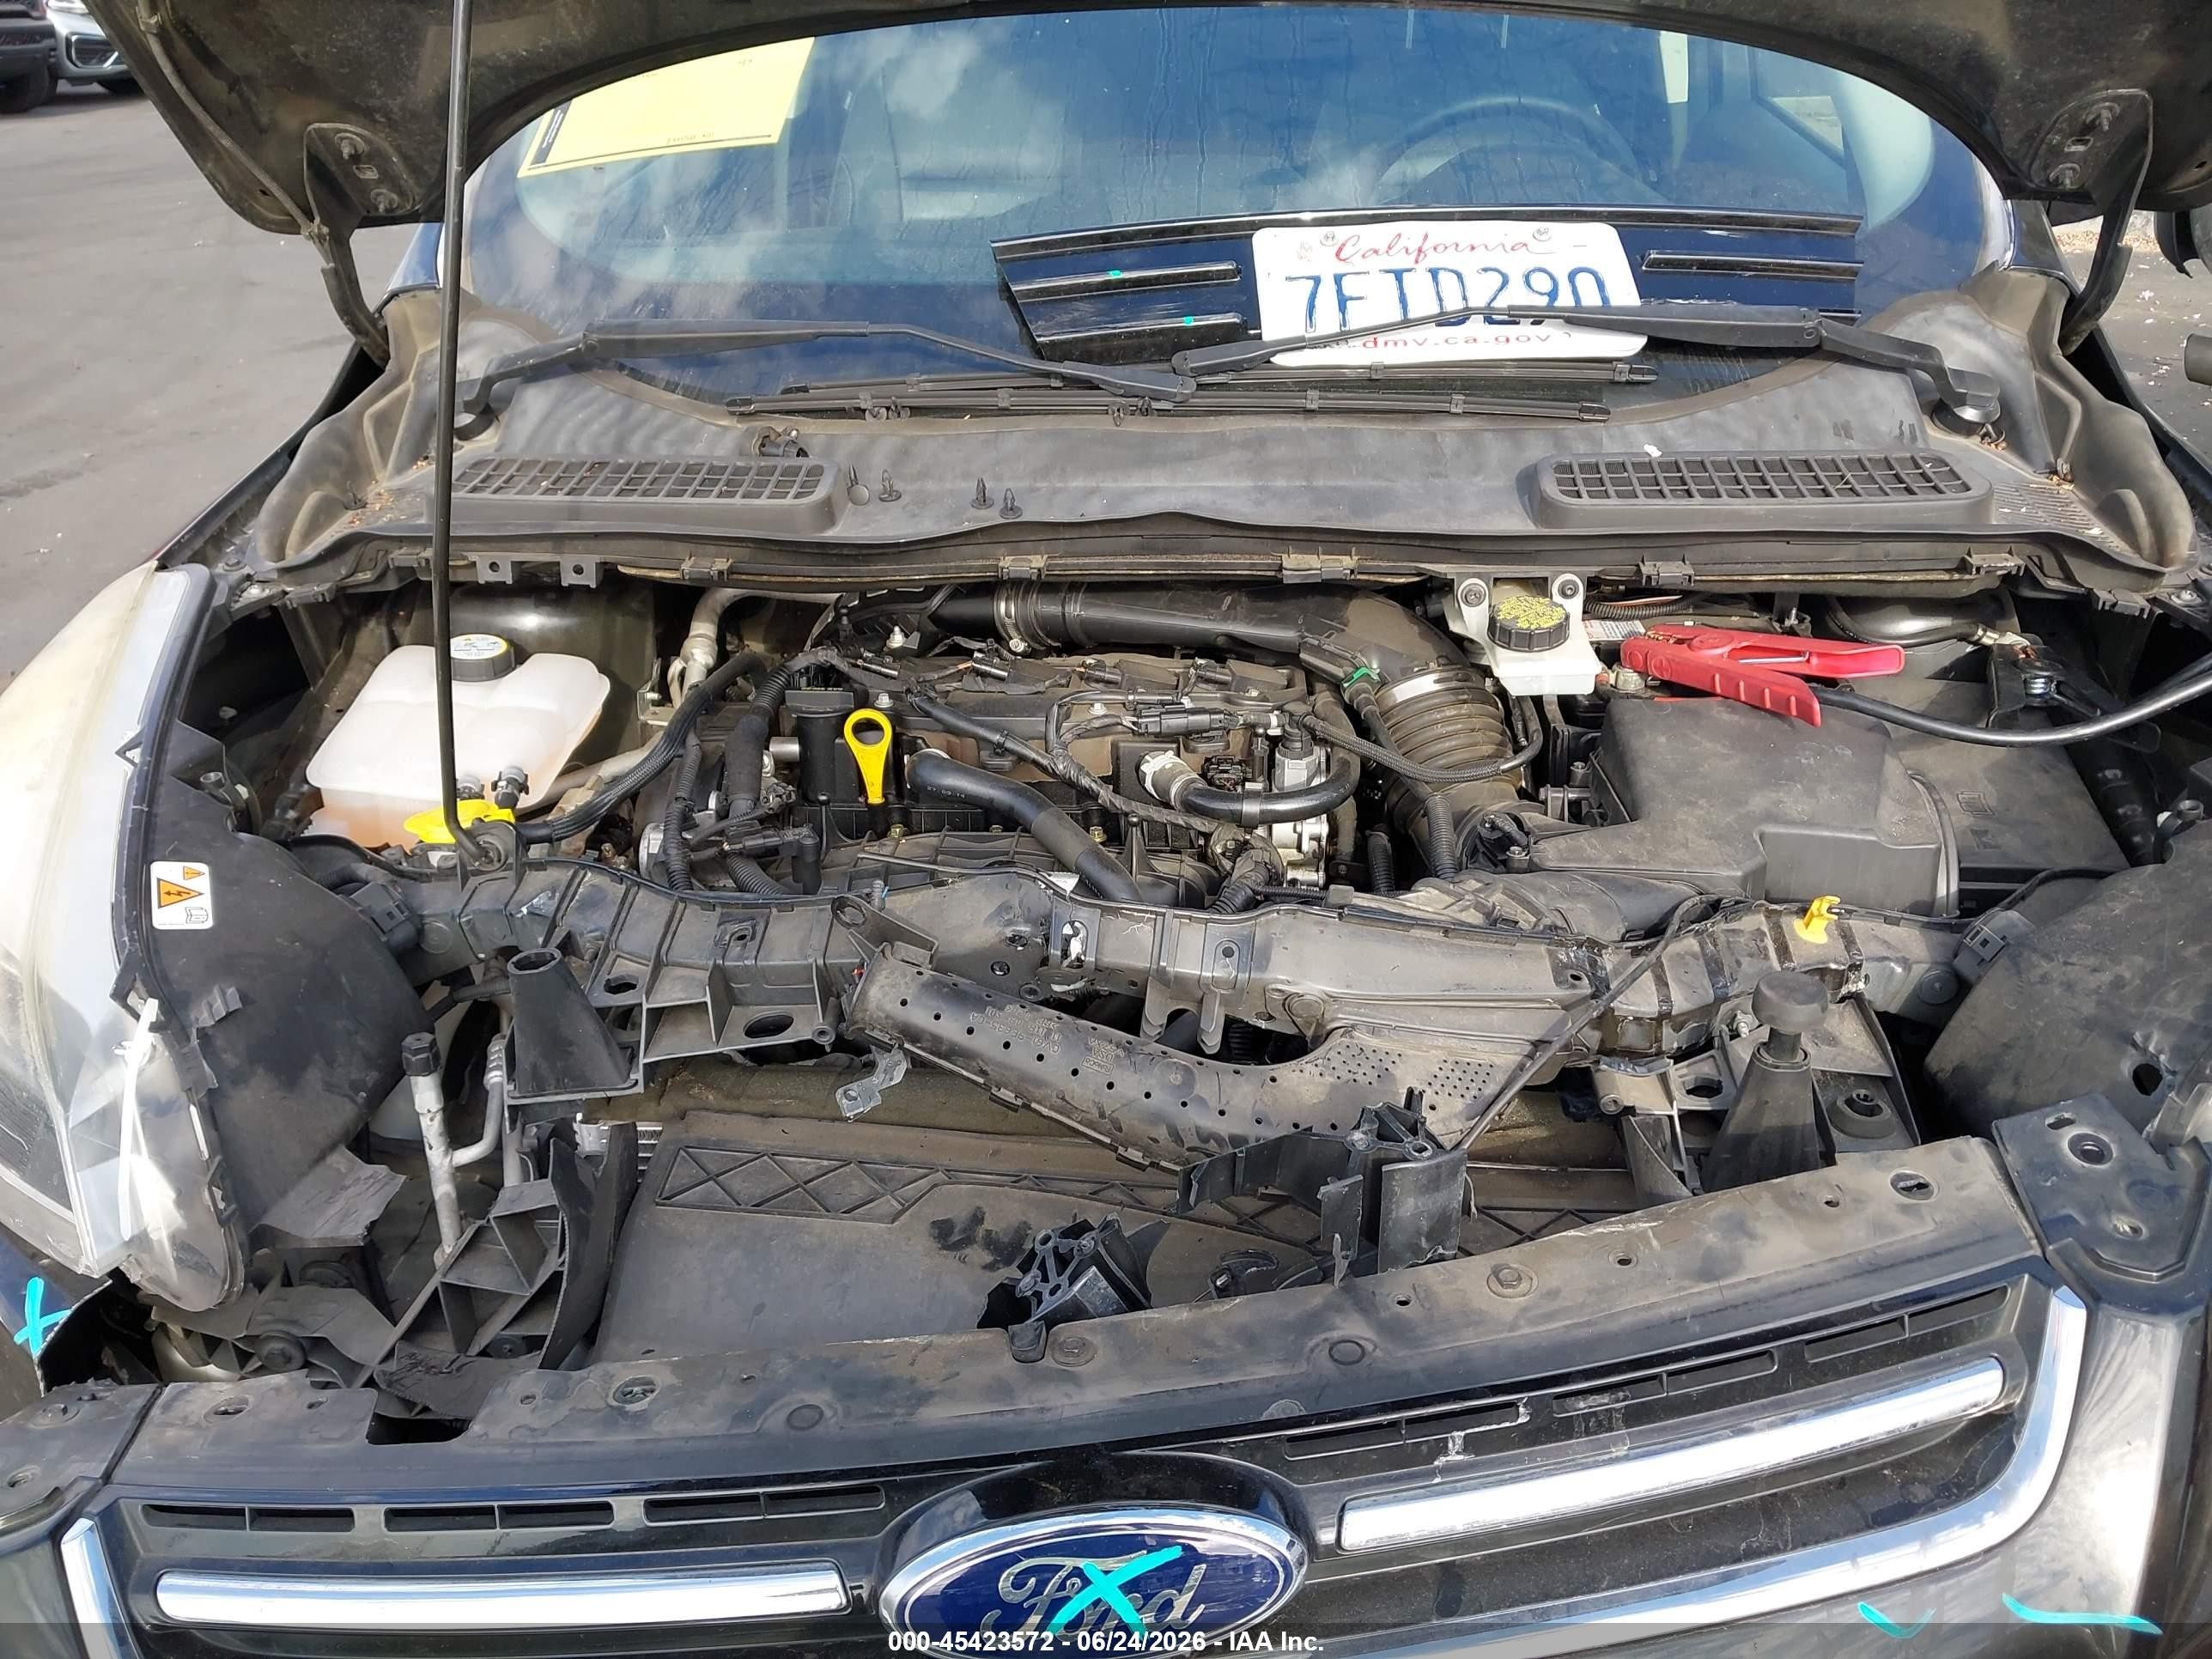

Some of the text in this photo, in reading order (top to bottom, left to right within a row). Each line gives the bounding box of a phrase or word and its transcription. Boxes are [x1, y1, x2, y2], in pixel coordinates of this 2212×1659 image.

[1334, 233, 1556, 265] California
[1285, 266, 1611, 334] 7FTD290
[1362, 331, 1552, 349] dmv.ca.gov
[1091, 1046, 1115, 1063] USA
